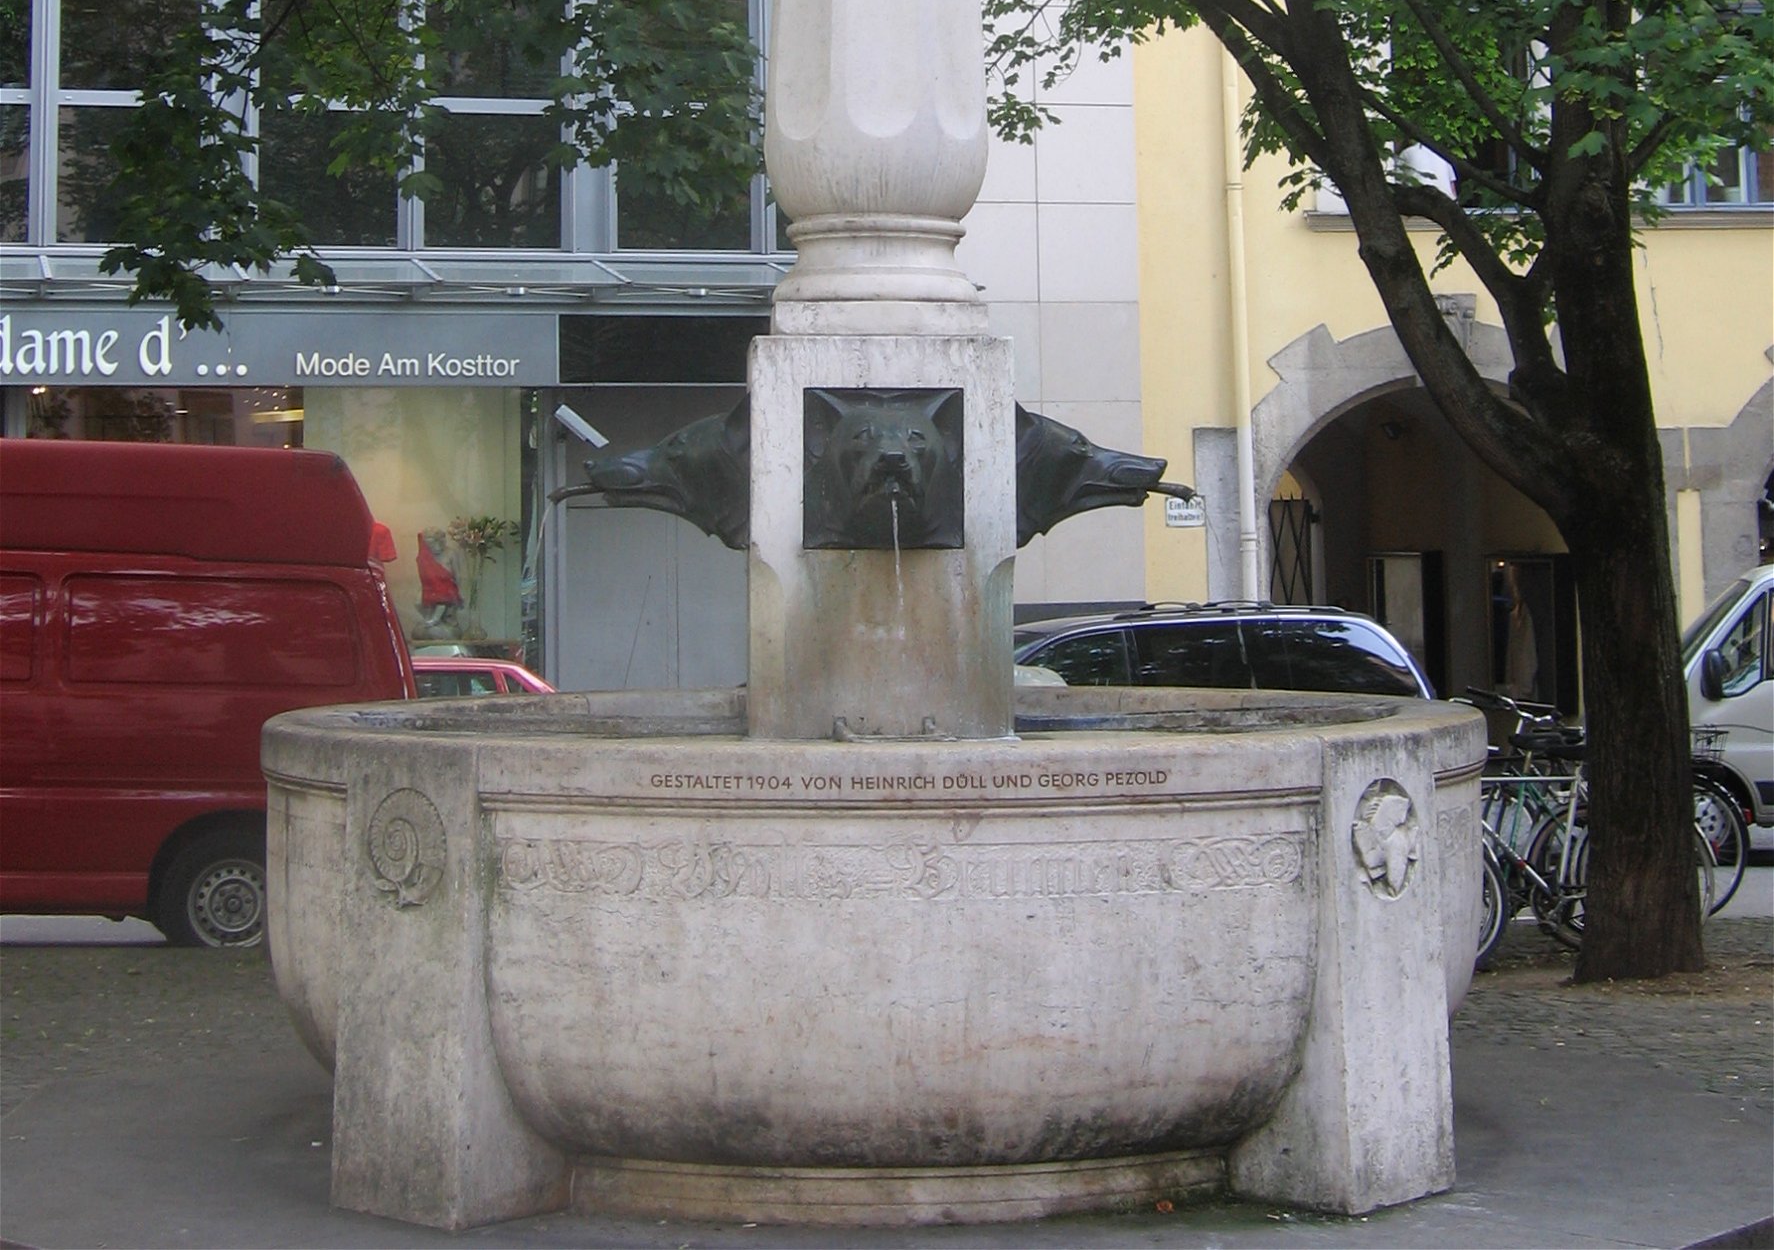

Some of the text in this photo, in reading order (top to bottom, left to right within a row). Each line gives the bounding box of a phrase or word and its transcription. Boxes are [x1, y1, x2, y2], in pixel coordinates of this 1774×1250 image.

[296, 352, 521, 376] Mode Am Kosttor
[650, 770, 1168, 790] GESTALTET 1904 VON HEINRICH DÜLL UND GEORG PEZOLD
